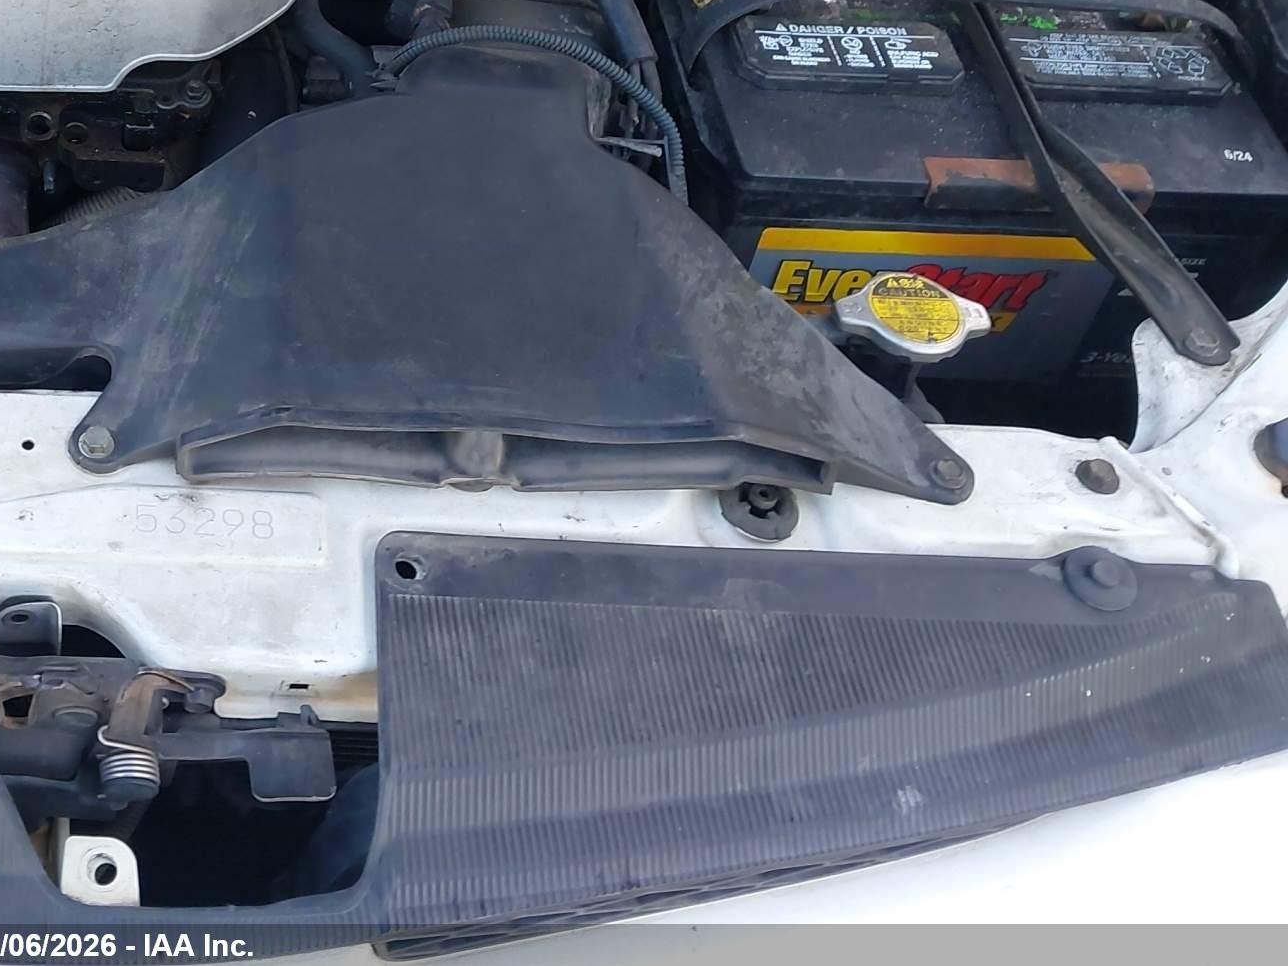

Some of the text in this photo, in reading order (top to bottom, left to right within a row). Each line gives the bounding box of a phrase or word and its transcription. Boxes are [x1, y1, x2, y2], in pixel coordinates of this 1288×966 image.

[789, 24, 844, 34] DANGER
[857, 26, 907, 36] POISON
[878, 287, 941, 298] CAUTION
[135, 504, 274, 539] 53298
